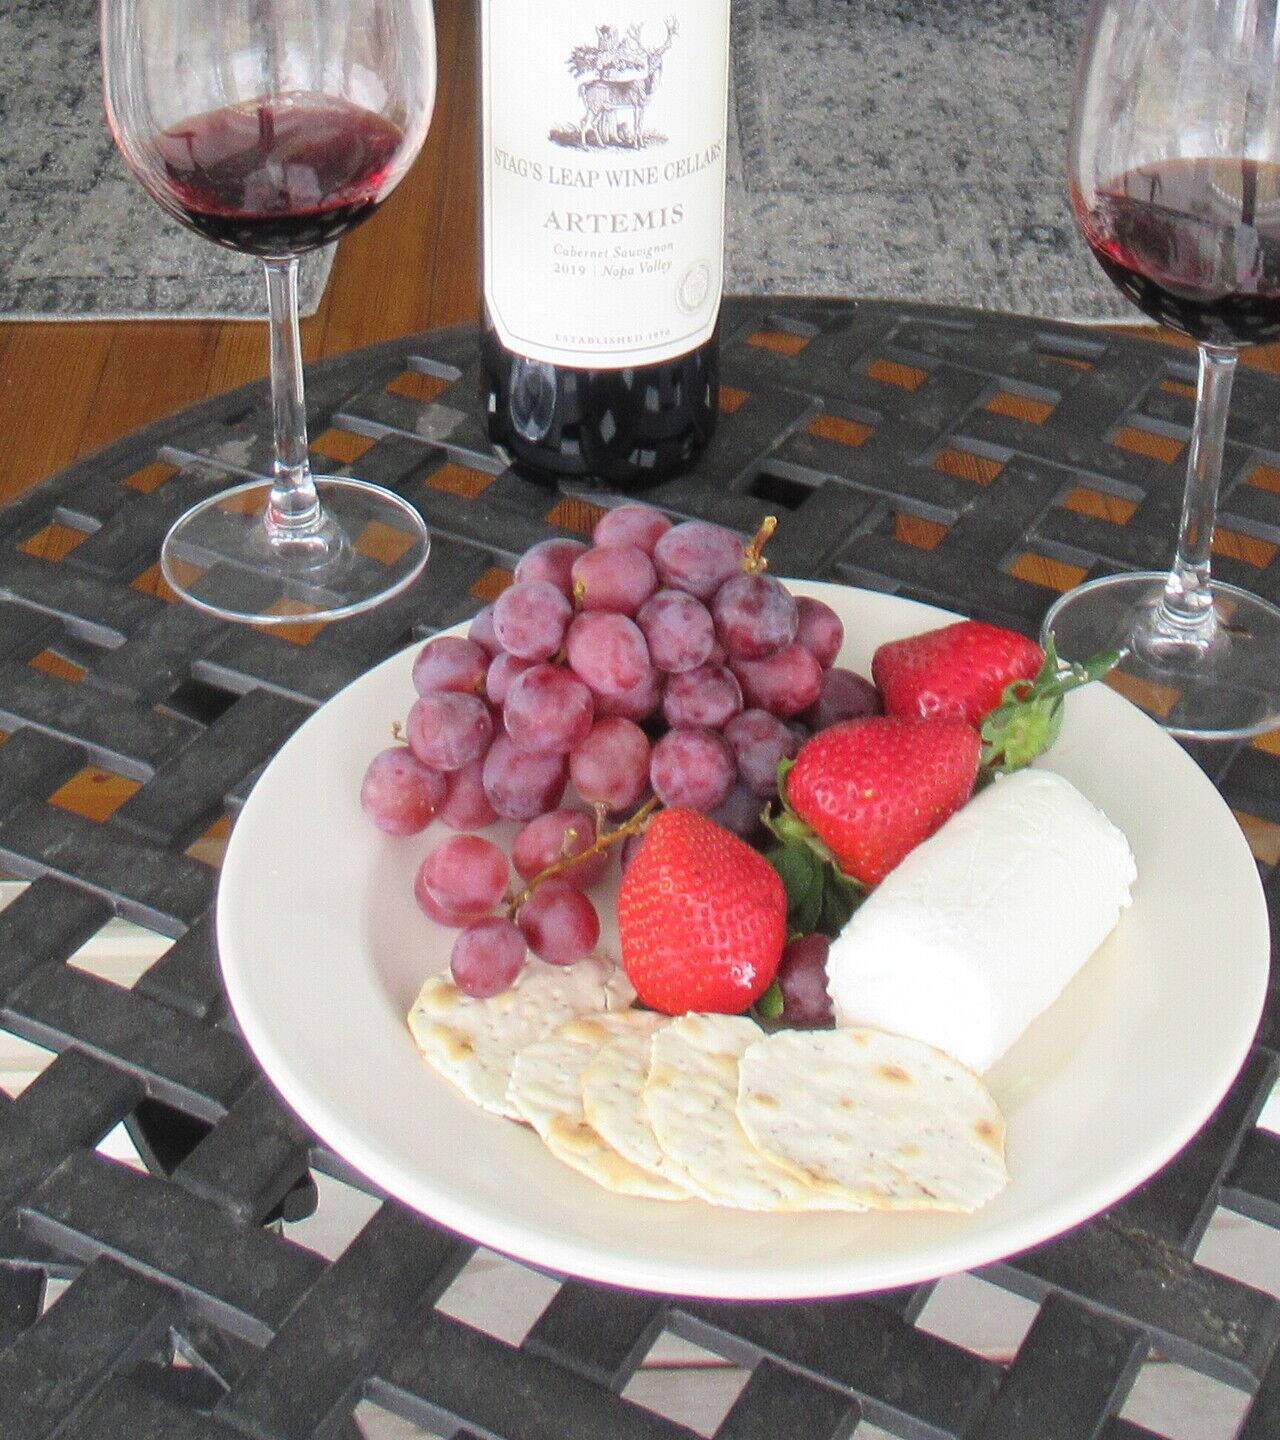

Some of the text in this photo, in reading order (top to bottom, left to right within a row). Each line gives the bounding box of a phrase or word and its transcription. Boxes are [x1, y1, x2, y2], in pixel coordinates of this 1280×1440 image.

[494, 146, 543, 181] STAG'S
[548, 165, 600, 188] LEAP
[605, 165, 659, 188] WINE
[543, 203, 684, 233] ARTEMIS
[553, 242, 674, 259] Cabernet Sauvignon
[601, 265, 634, 280] Napa
[639, 259, 673, 274] Valley
